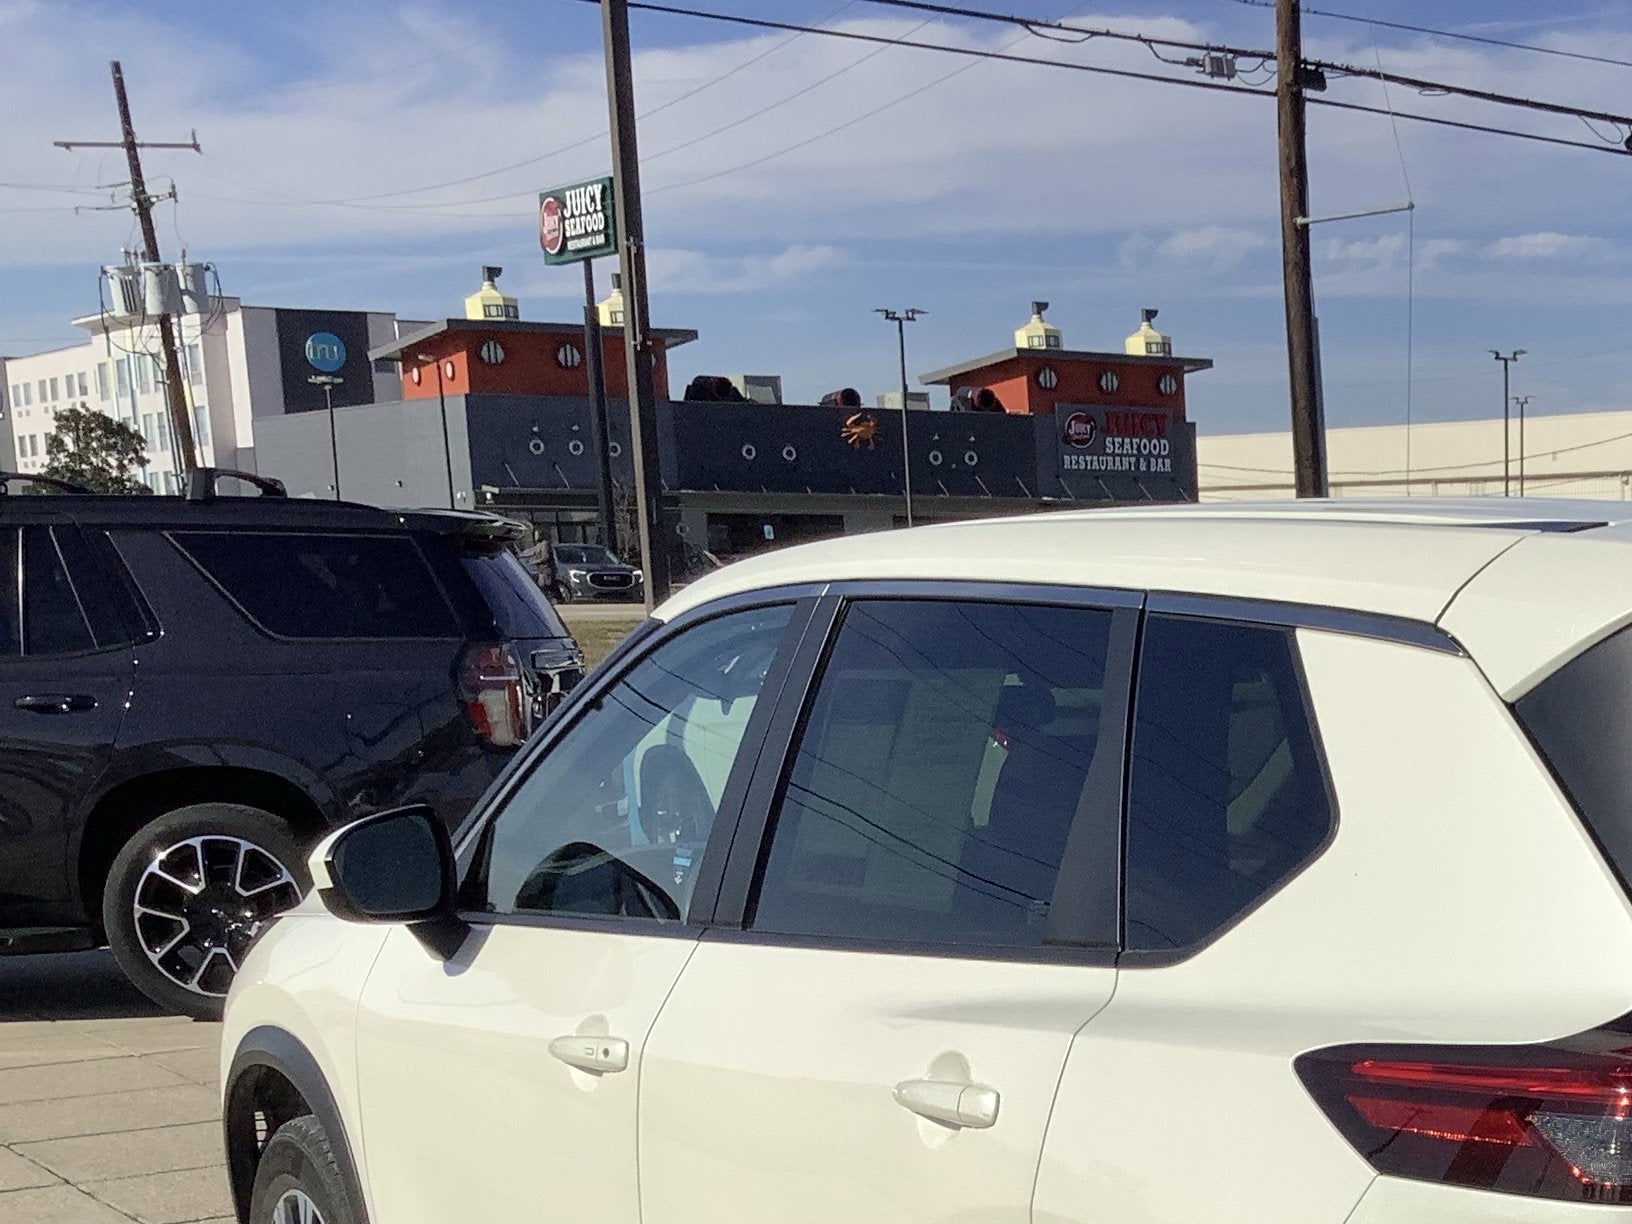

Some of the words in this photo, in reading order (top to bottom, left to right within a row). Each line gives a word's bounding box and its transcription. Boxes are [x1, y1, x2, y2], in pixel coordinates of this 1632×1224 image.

[563, 183, 602, 218] JUICY
[564, 212, 604, 238] SEAFOOD
[1105, 437, 1169, 455] SEAFOOD
[1063, 454, 1136, 471] RESTAURANT
[1139, 457, 1147, 471] &
[1149, 457, 1171, 472] BAR
